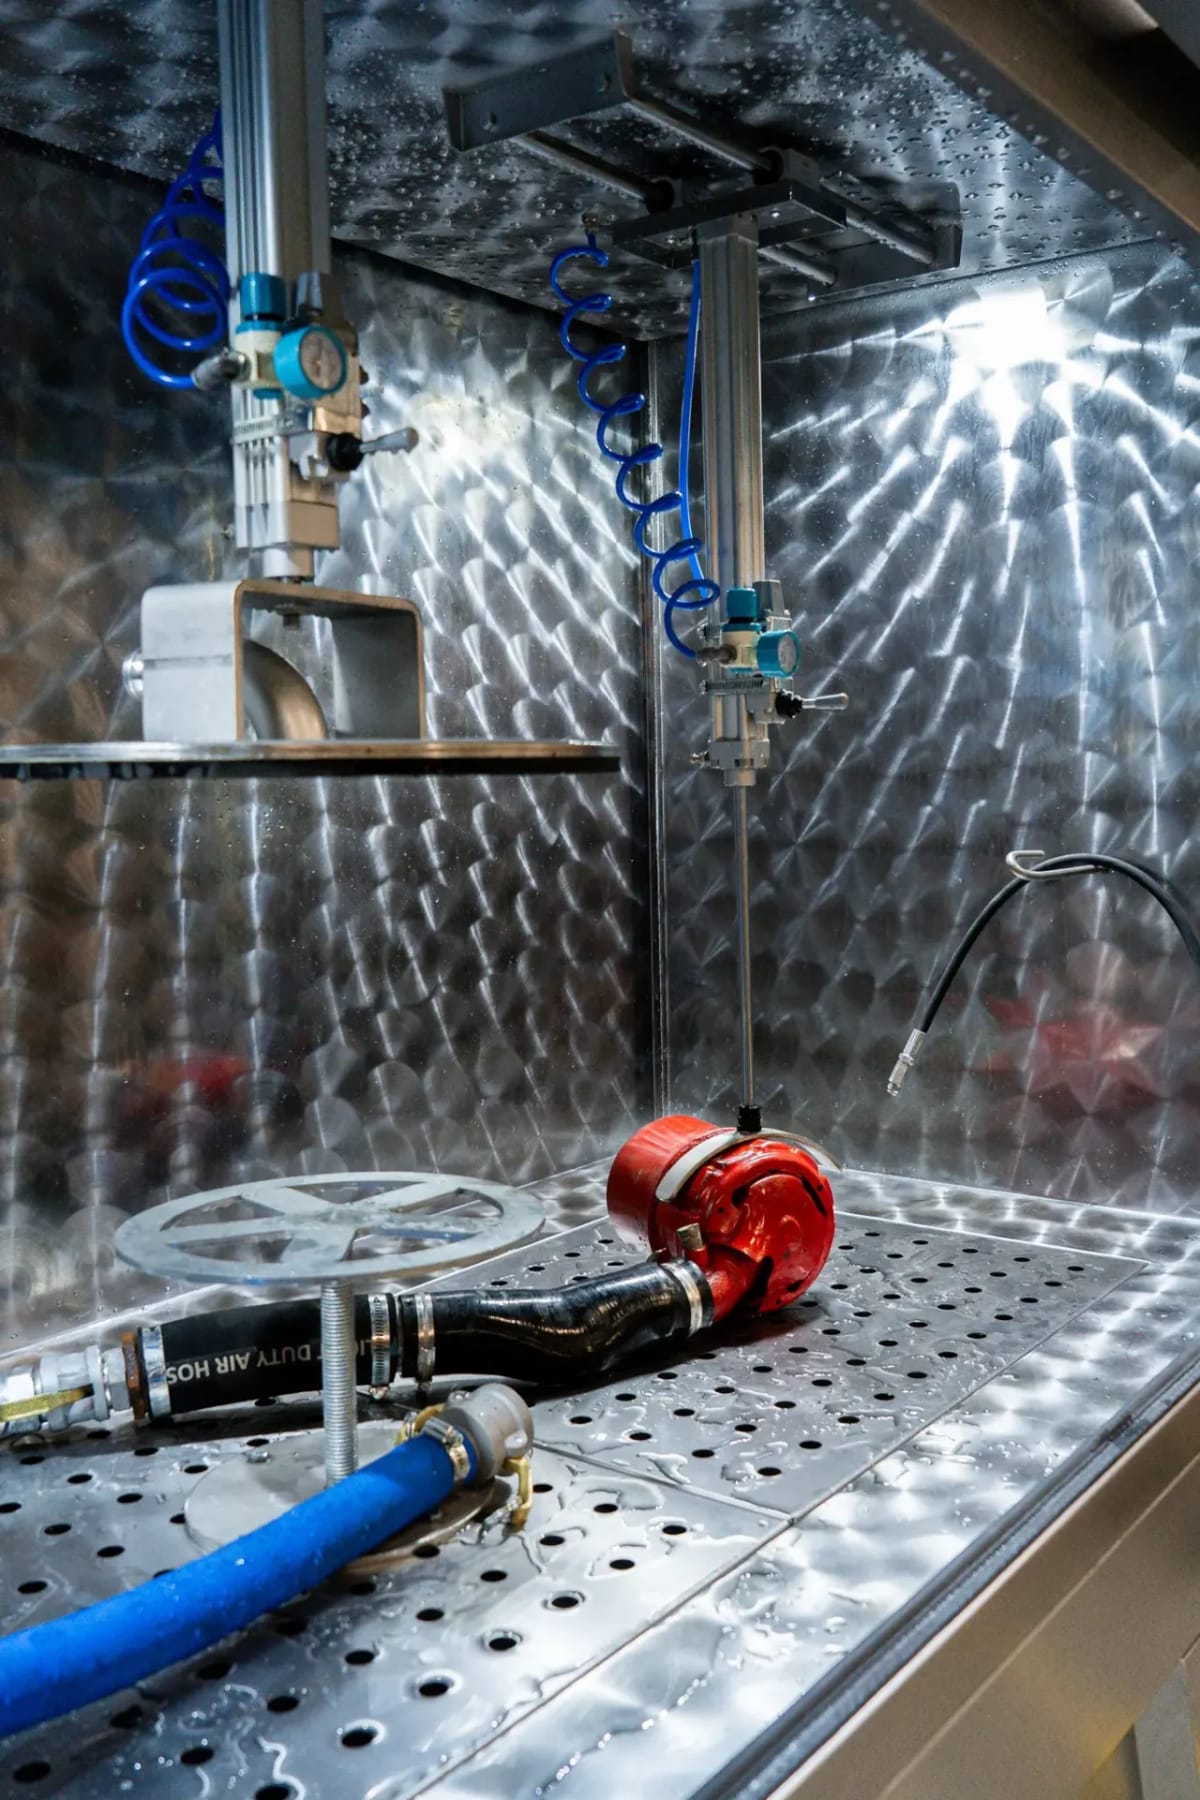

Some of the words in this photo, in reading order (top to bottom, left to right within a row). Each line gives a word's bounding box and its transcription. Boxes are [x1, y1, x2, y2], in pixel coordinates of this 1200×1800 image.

[214, 1352, 250, 1375] AIR
[255, 1344, 312, 1367] DUTY
[166, 1359, 210, 1385] HOS
